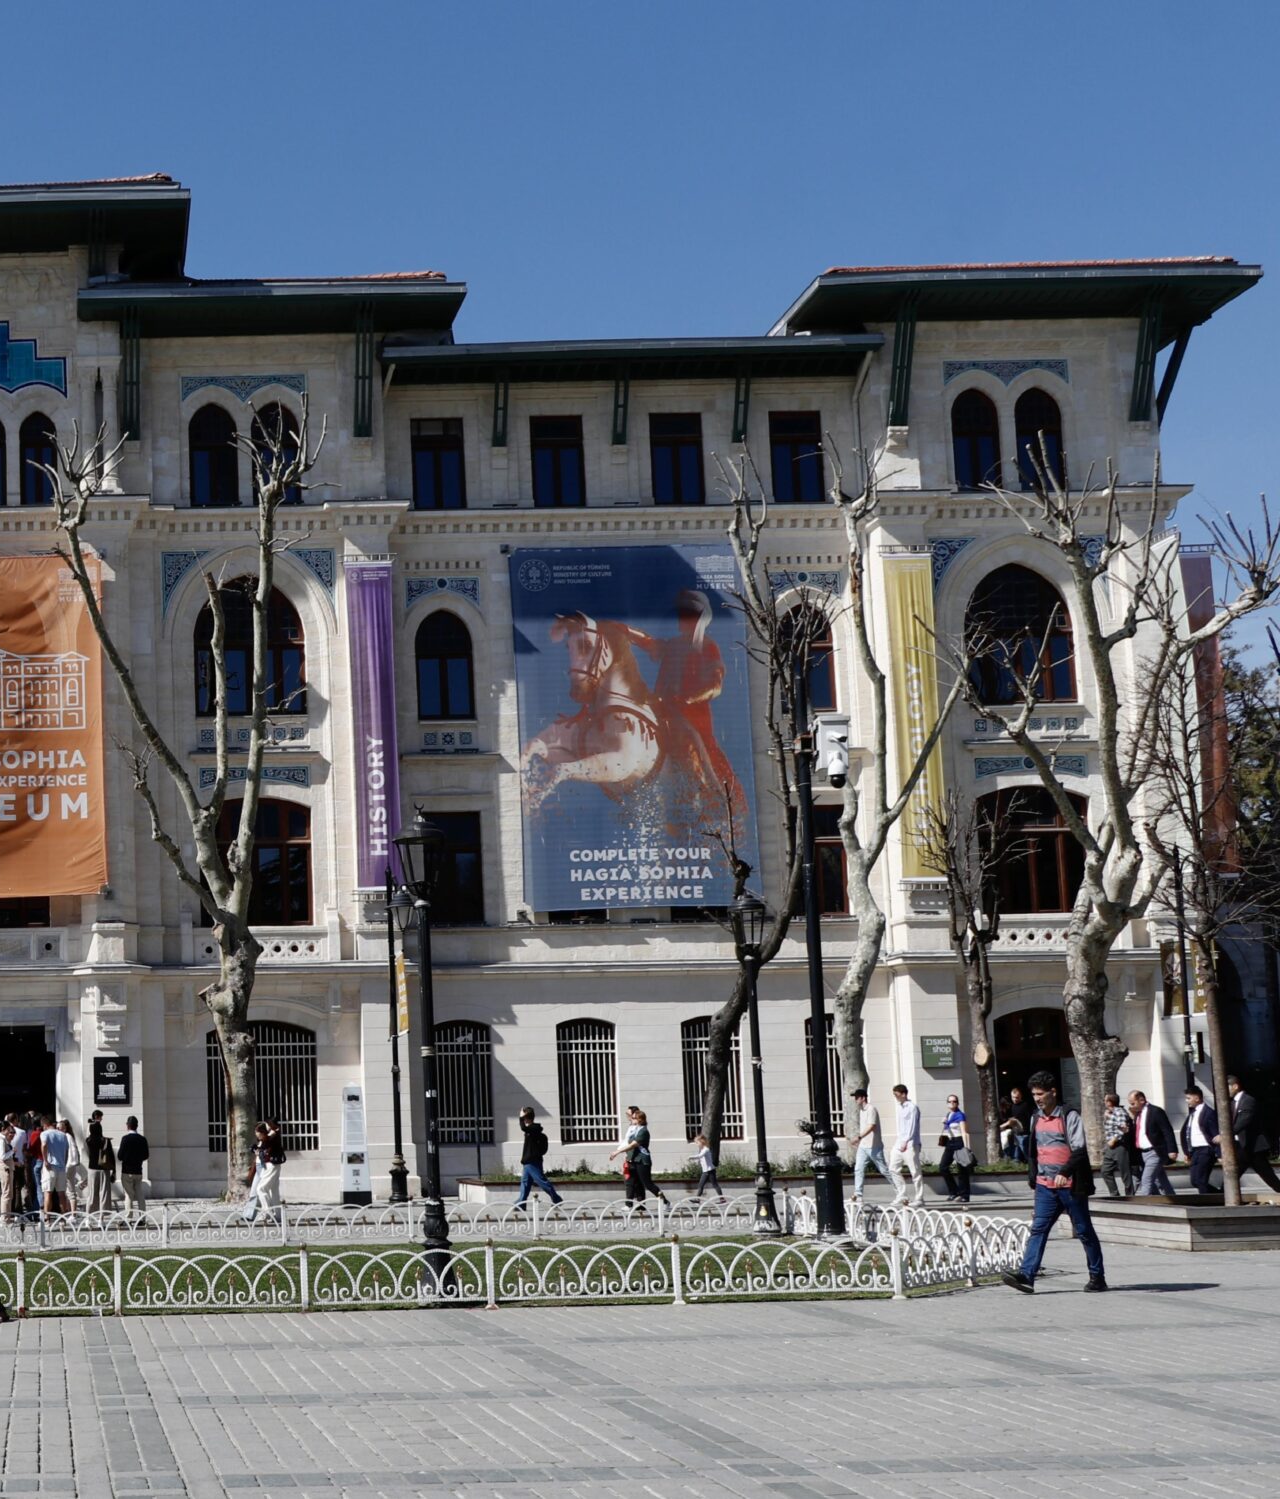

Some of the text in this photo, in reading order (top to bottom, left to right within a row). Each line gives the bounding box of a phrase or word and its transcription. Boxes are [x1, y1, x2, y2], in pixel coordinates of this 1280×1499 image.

[367, 734, 388, 856] HISTORY
[570, 848, 711, 862] COMPLETE YOUR
[571, 866, 713, 882] HAGIA SOPHIA
[581, 885, 704, 900] EXPERIENCE
[933, 1045, 951, 1054] shop
